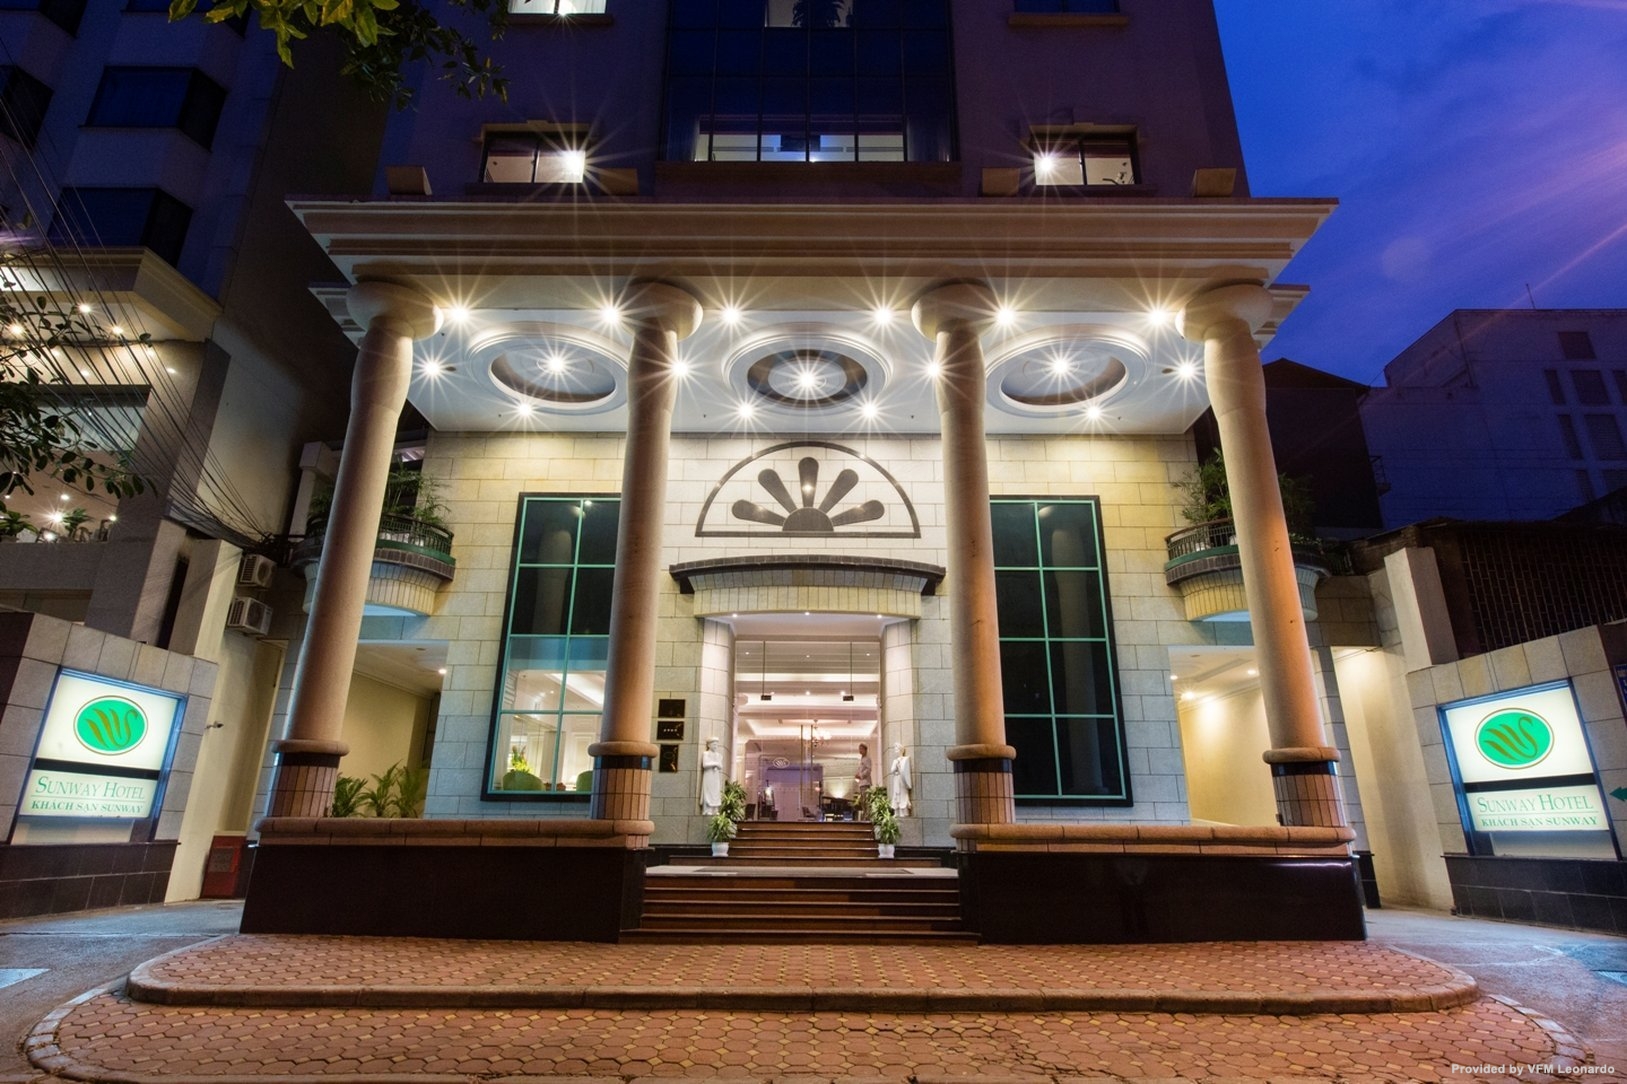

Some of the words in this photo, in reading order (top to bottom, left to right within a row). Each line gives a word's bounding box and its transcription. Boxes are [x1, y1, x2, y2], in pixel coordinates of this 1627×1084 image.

[35, 776, 101, 797] SUNWAY
[103, 781, 145, 800] HOTEL
[100, 804, 144, 814] SUNWAY
[1477, 797, 1536, 813] SUNWAY
[1537, 794, 1594, 811] HOTEL
[1544, 816, 1598, 826] SUNWAY
